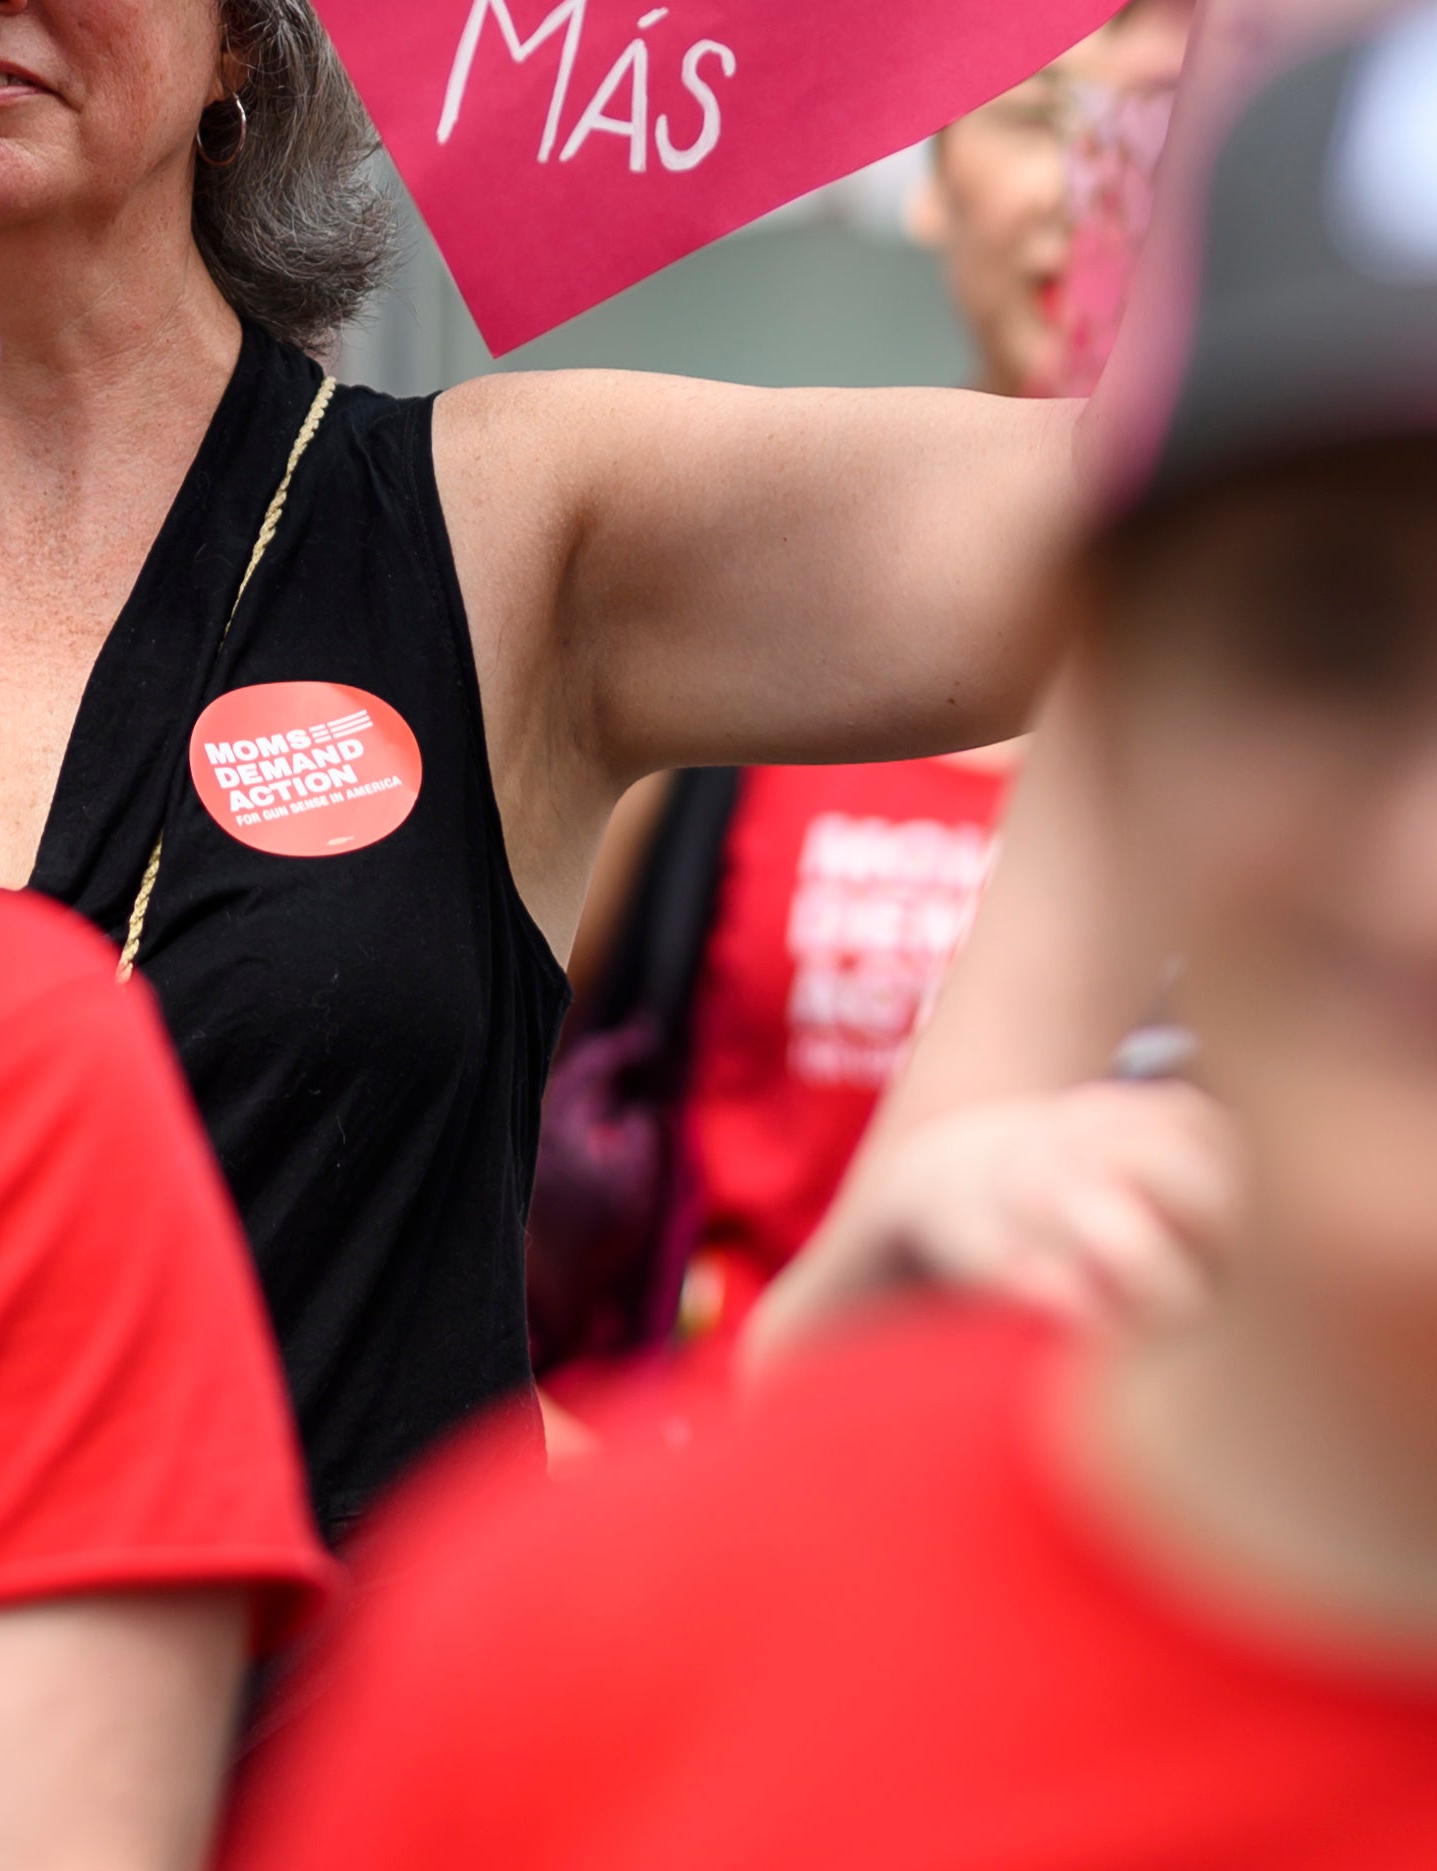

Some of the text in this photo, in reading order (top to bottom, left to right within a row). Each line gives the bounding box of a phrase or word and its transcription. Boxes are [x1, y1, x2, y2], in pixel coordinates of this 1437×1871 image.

[204, 728, 312, 765] MOMS
[214, 739, 364, 789] DEMAND
[229, 764, 359, 813] ACTION
[235, 775, 403, 827] FOR GUN SENSE IN AMERICA
